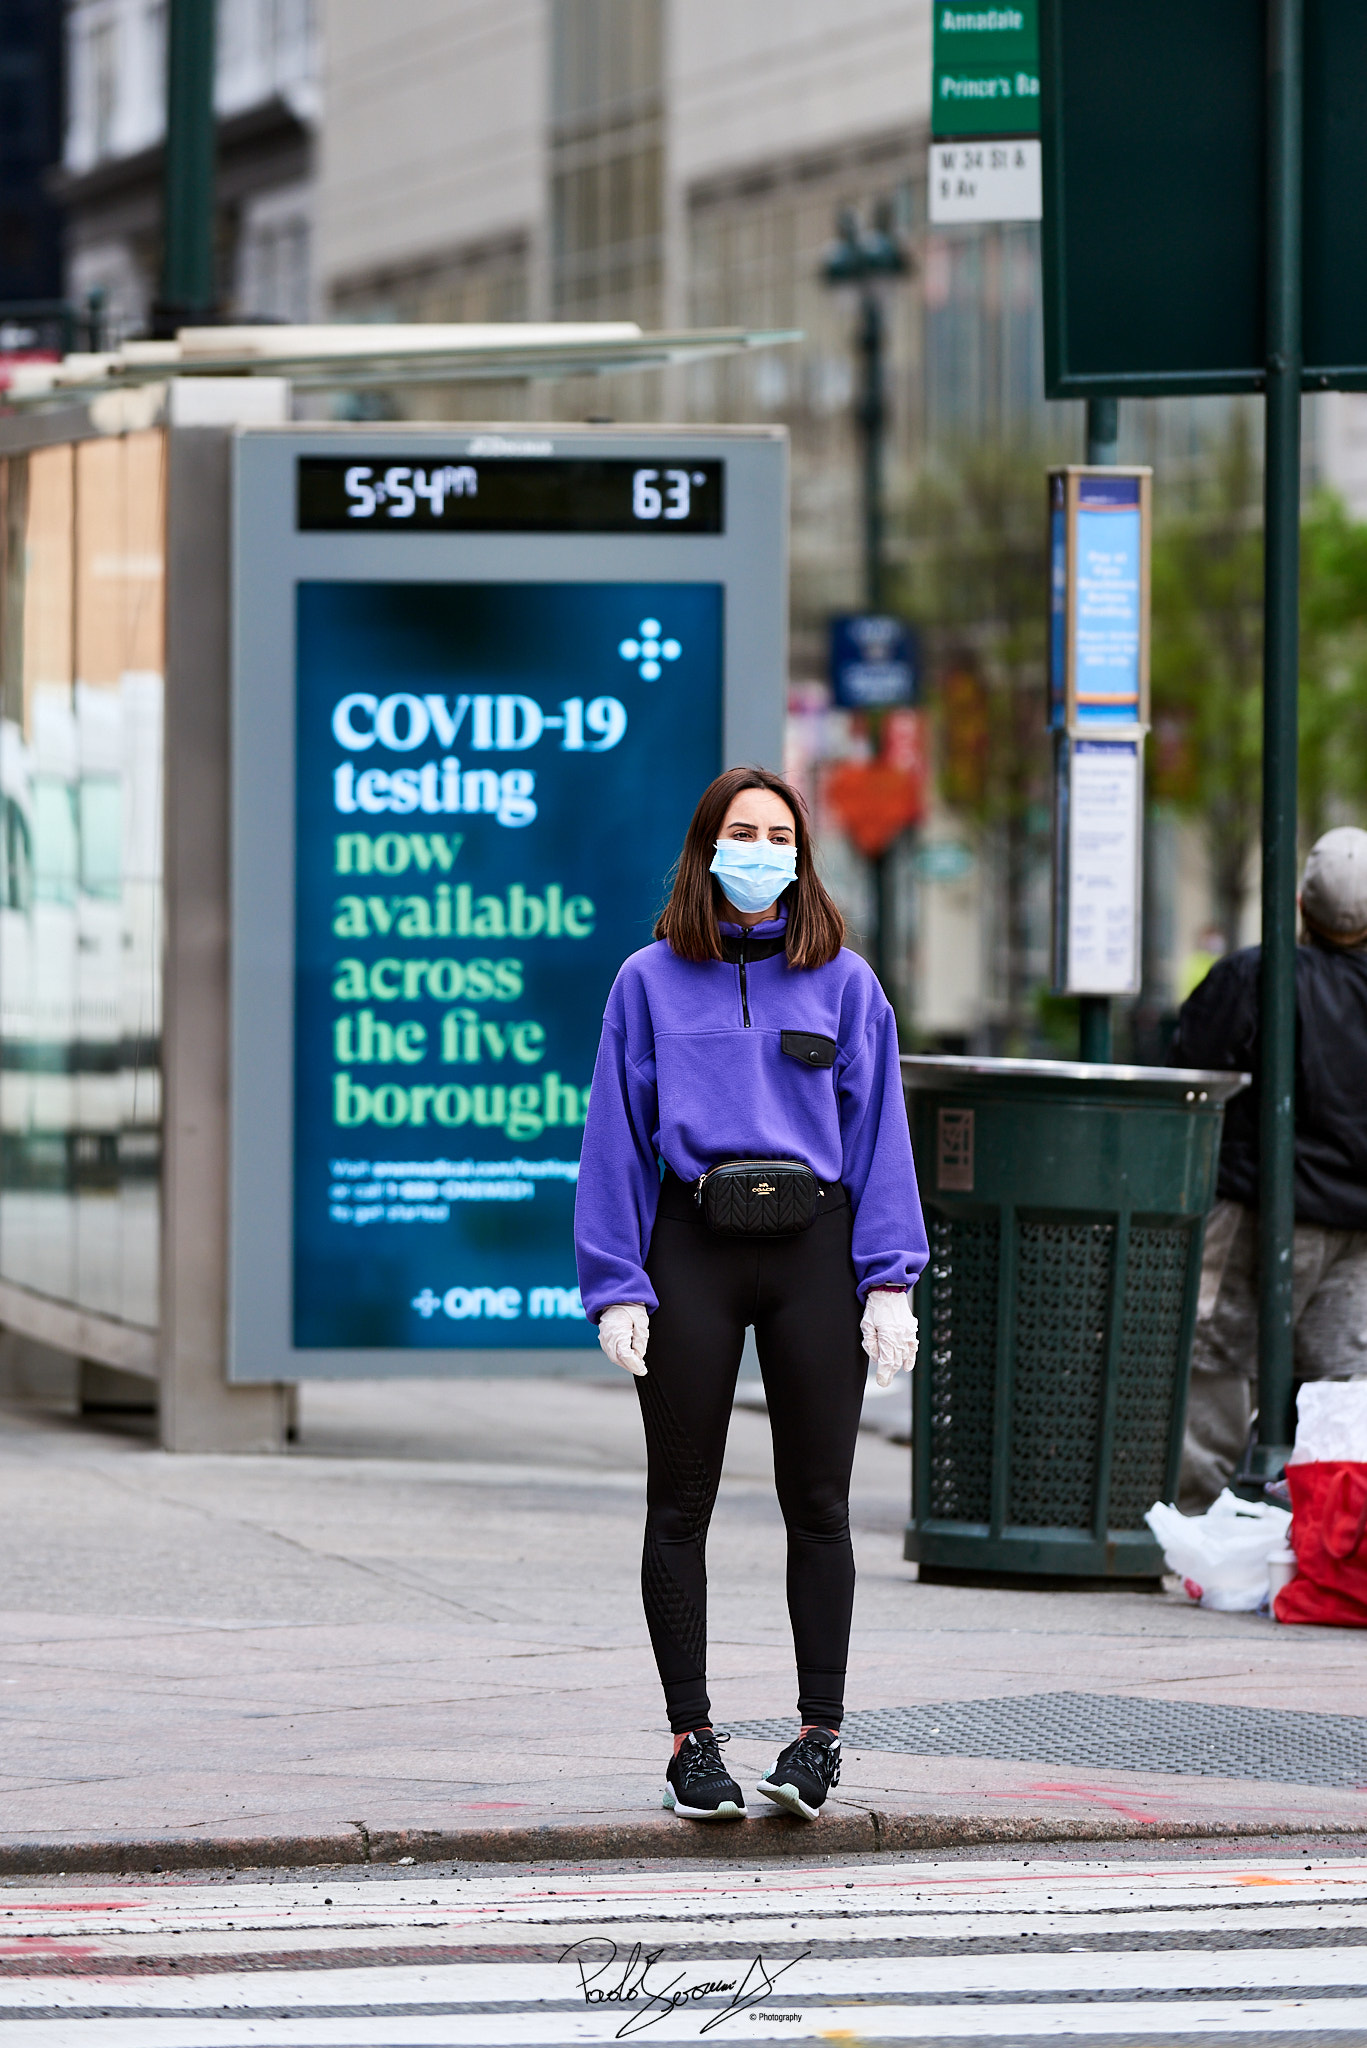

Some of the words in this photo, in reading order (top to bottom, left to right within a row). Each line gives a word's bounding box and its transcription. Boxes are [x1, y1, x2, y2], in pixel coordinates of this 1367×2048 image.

[941, 9, 1023, 31] Annadale
[940, 76, 1011, 97] Prince's
[963, 151, 983, 171] 34
[332, 692, 627, 752] COVID-19
[334, 756, 538, 828] testing
[334, 832, 462, 876] now
[333, 882, 596, 938] available
[333, 958, 524, 1001] across
[334, 1009, 427, 1064] the
[441, 1008, 545, 1064] five
[443, 1286, 522, 1320] one
